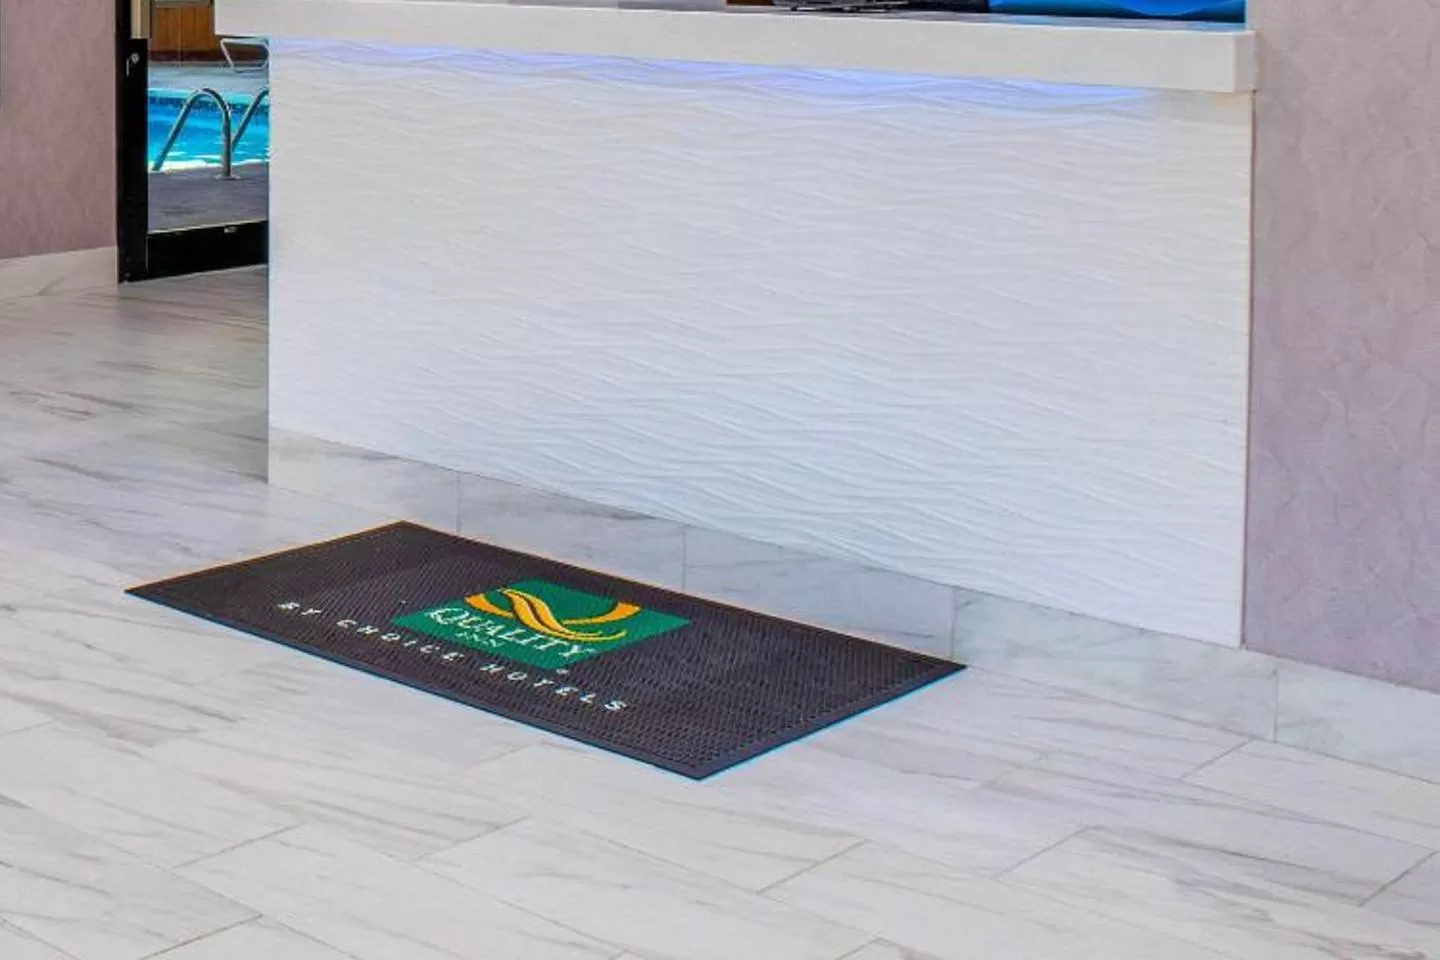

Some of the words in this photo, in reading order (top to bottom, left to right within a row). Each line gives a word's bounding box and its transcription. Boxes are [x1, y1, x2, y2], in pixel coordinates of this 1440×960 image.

[277, 601, 321, 617] BY
[336, 619, 464, 663] CHOICE
[479, 663, 627, 711] HOTELS
[424, 607, 597, 657] QUALITY
